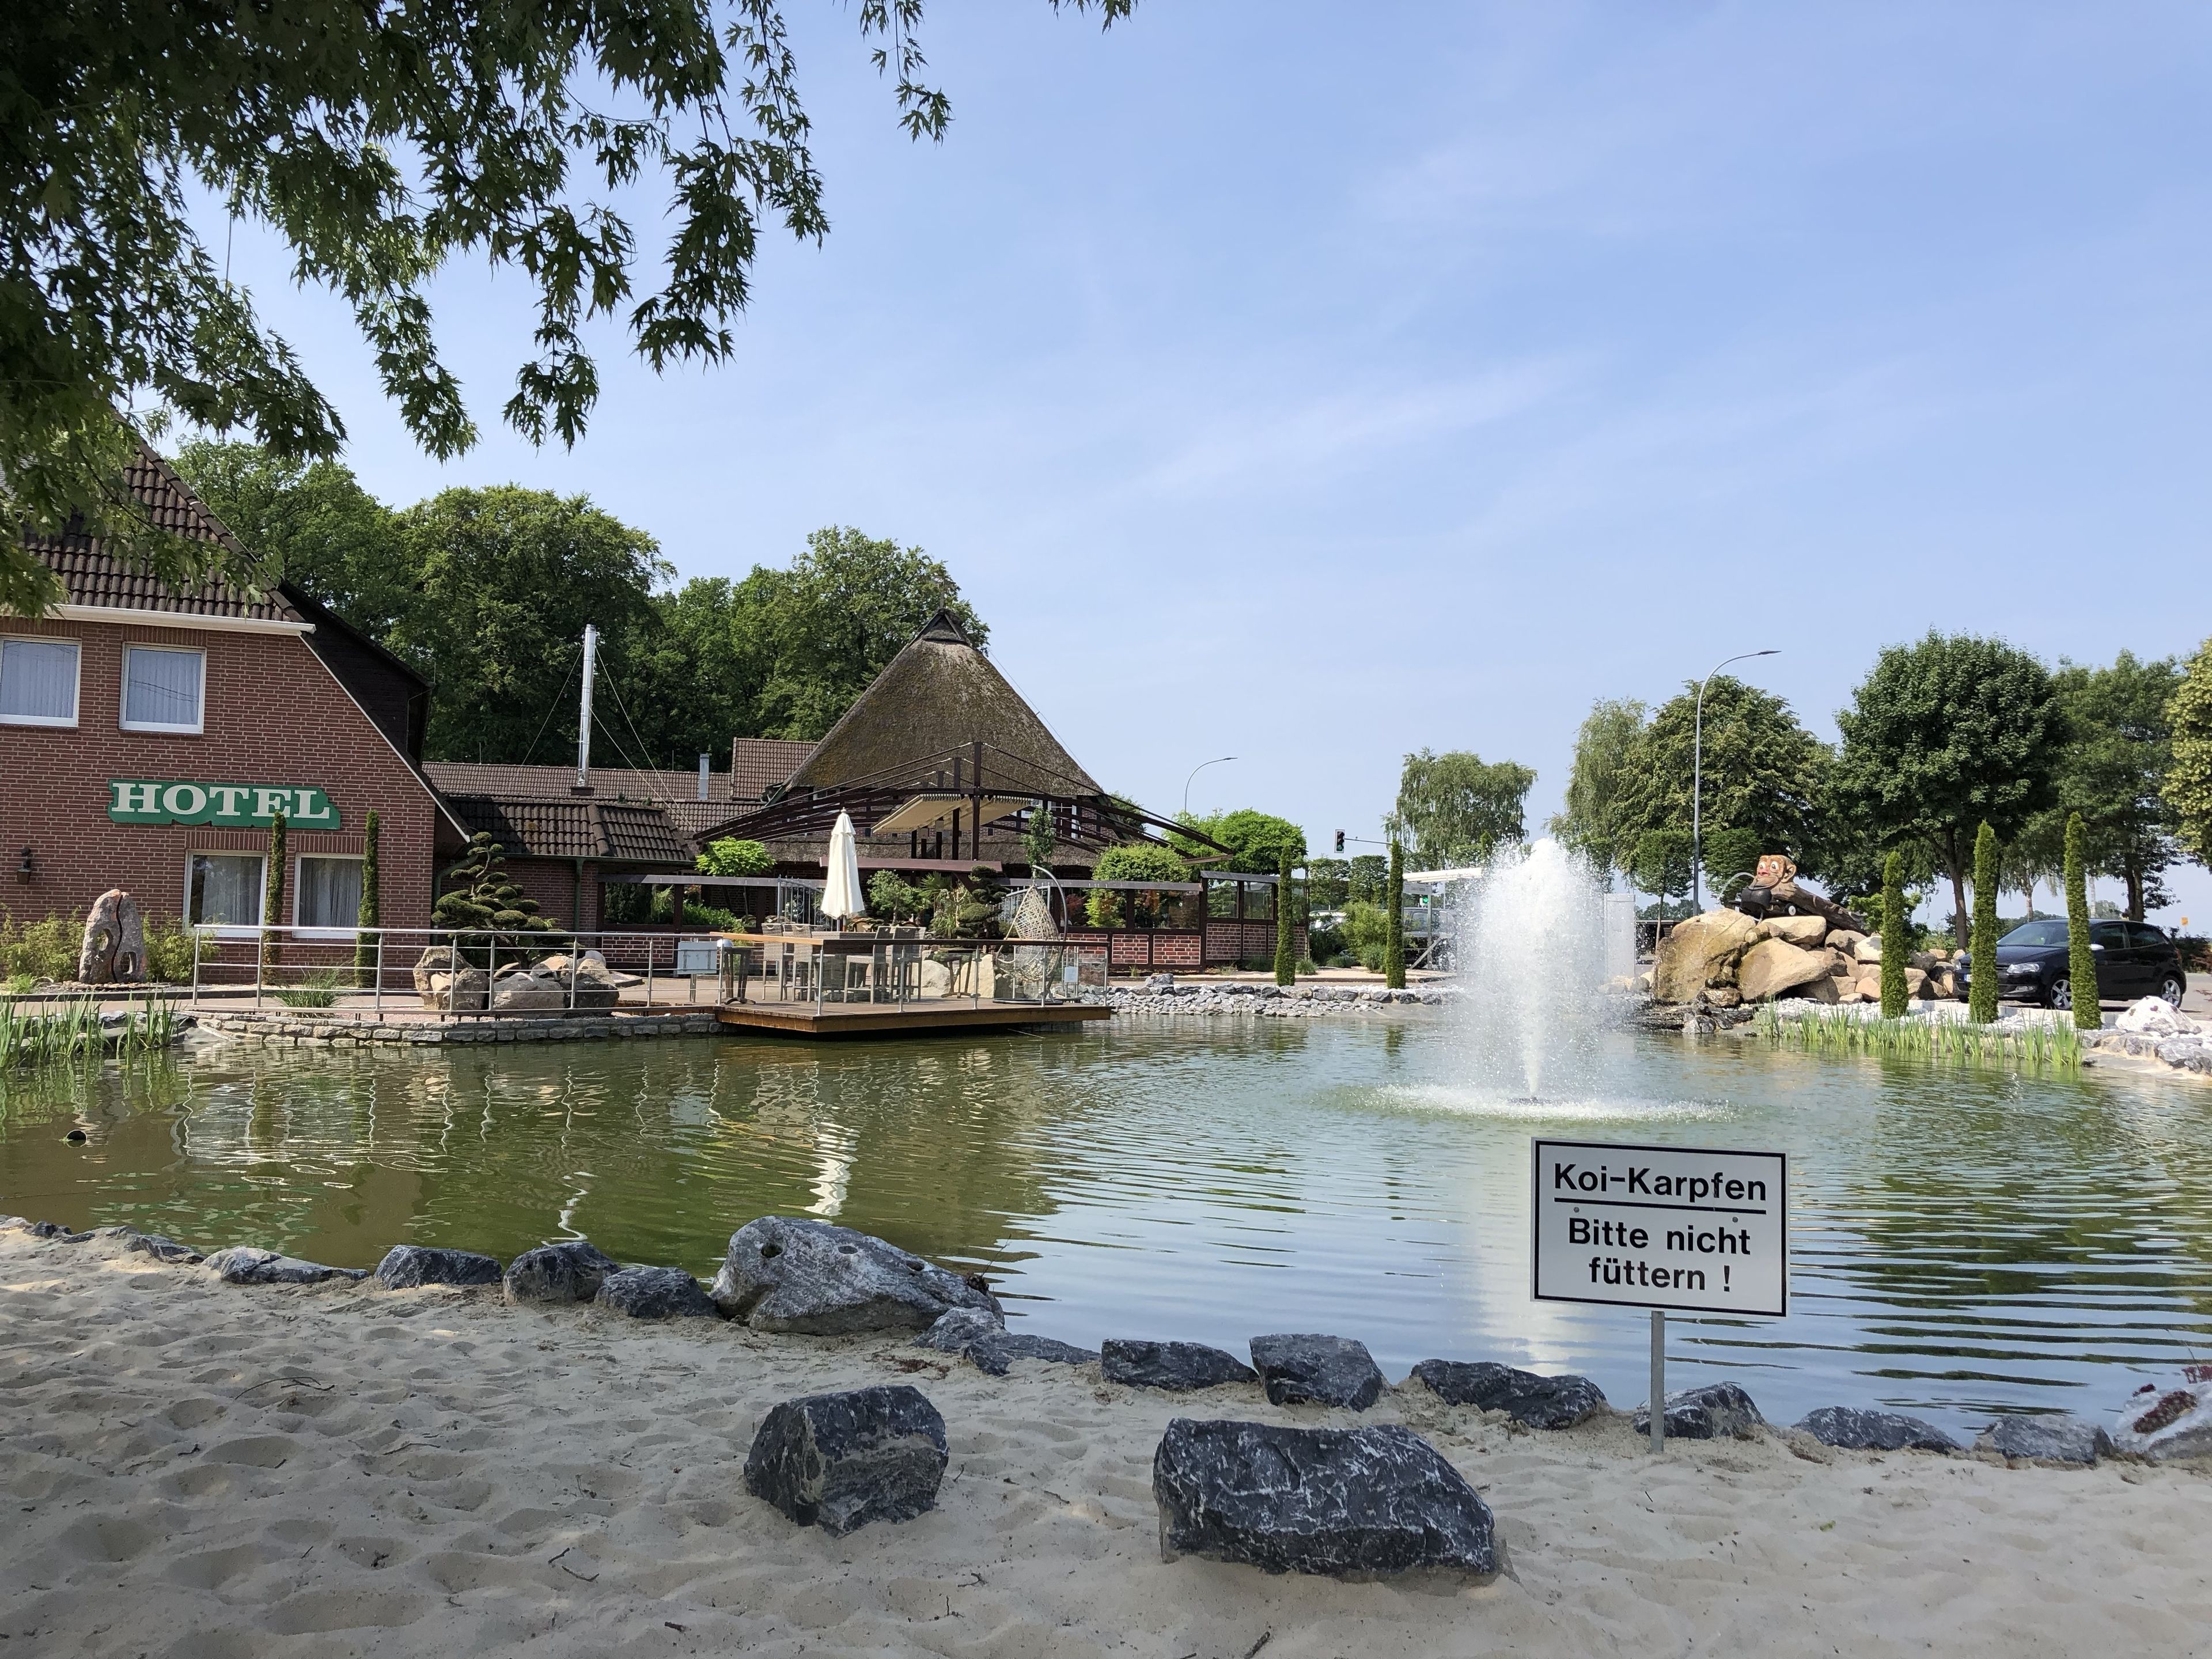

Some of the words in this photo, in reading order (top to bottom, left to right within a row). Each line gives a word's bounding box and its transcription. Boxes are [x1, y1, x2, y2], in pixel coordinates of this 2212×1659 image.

[111, 783, 331, 819] HOTEL
[1555, 1162, 1767, 1203] Koi-Karpfen
[1569, 1217, 1649, 1249] Bitte
[1666, 1225, 1751, 1255] nicht
[1588, 1256, 1706, 1290] füttern
